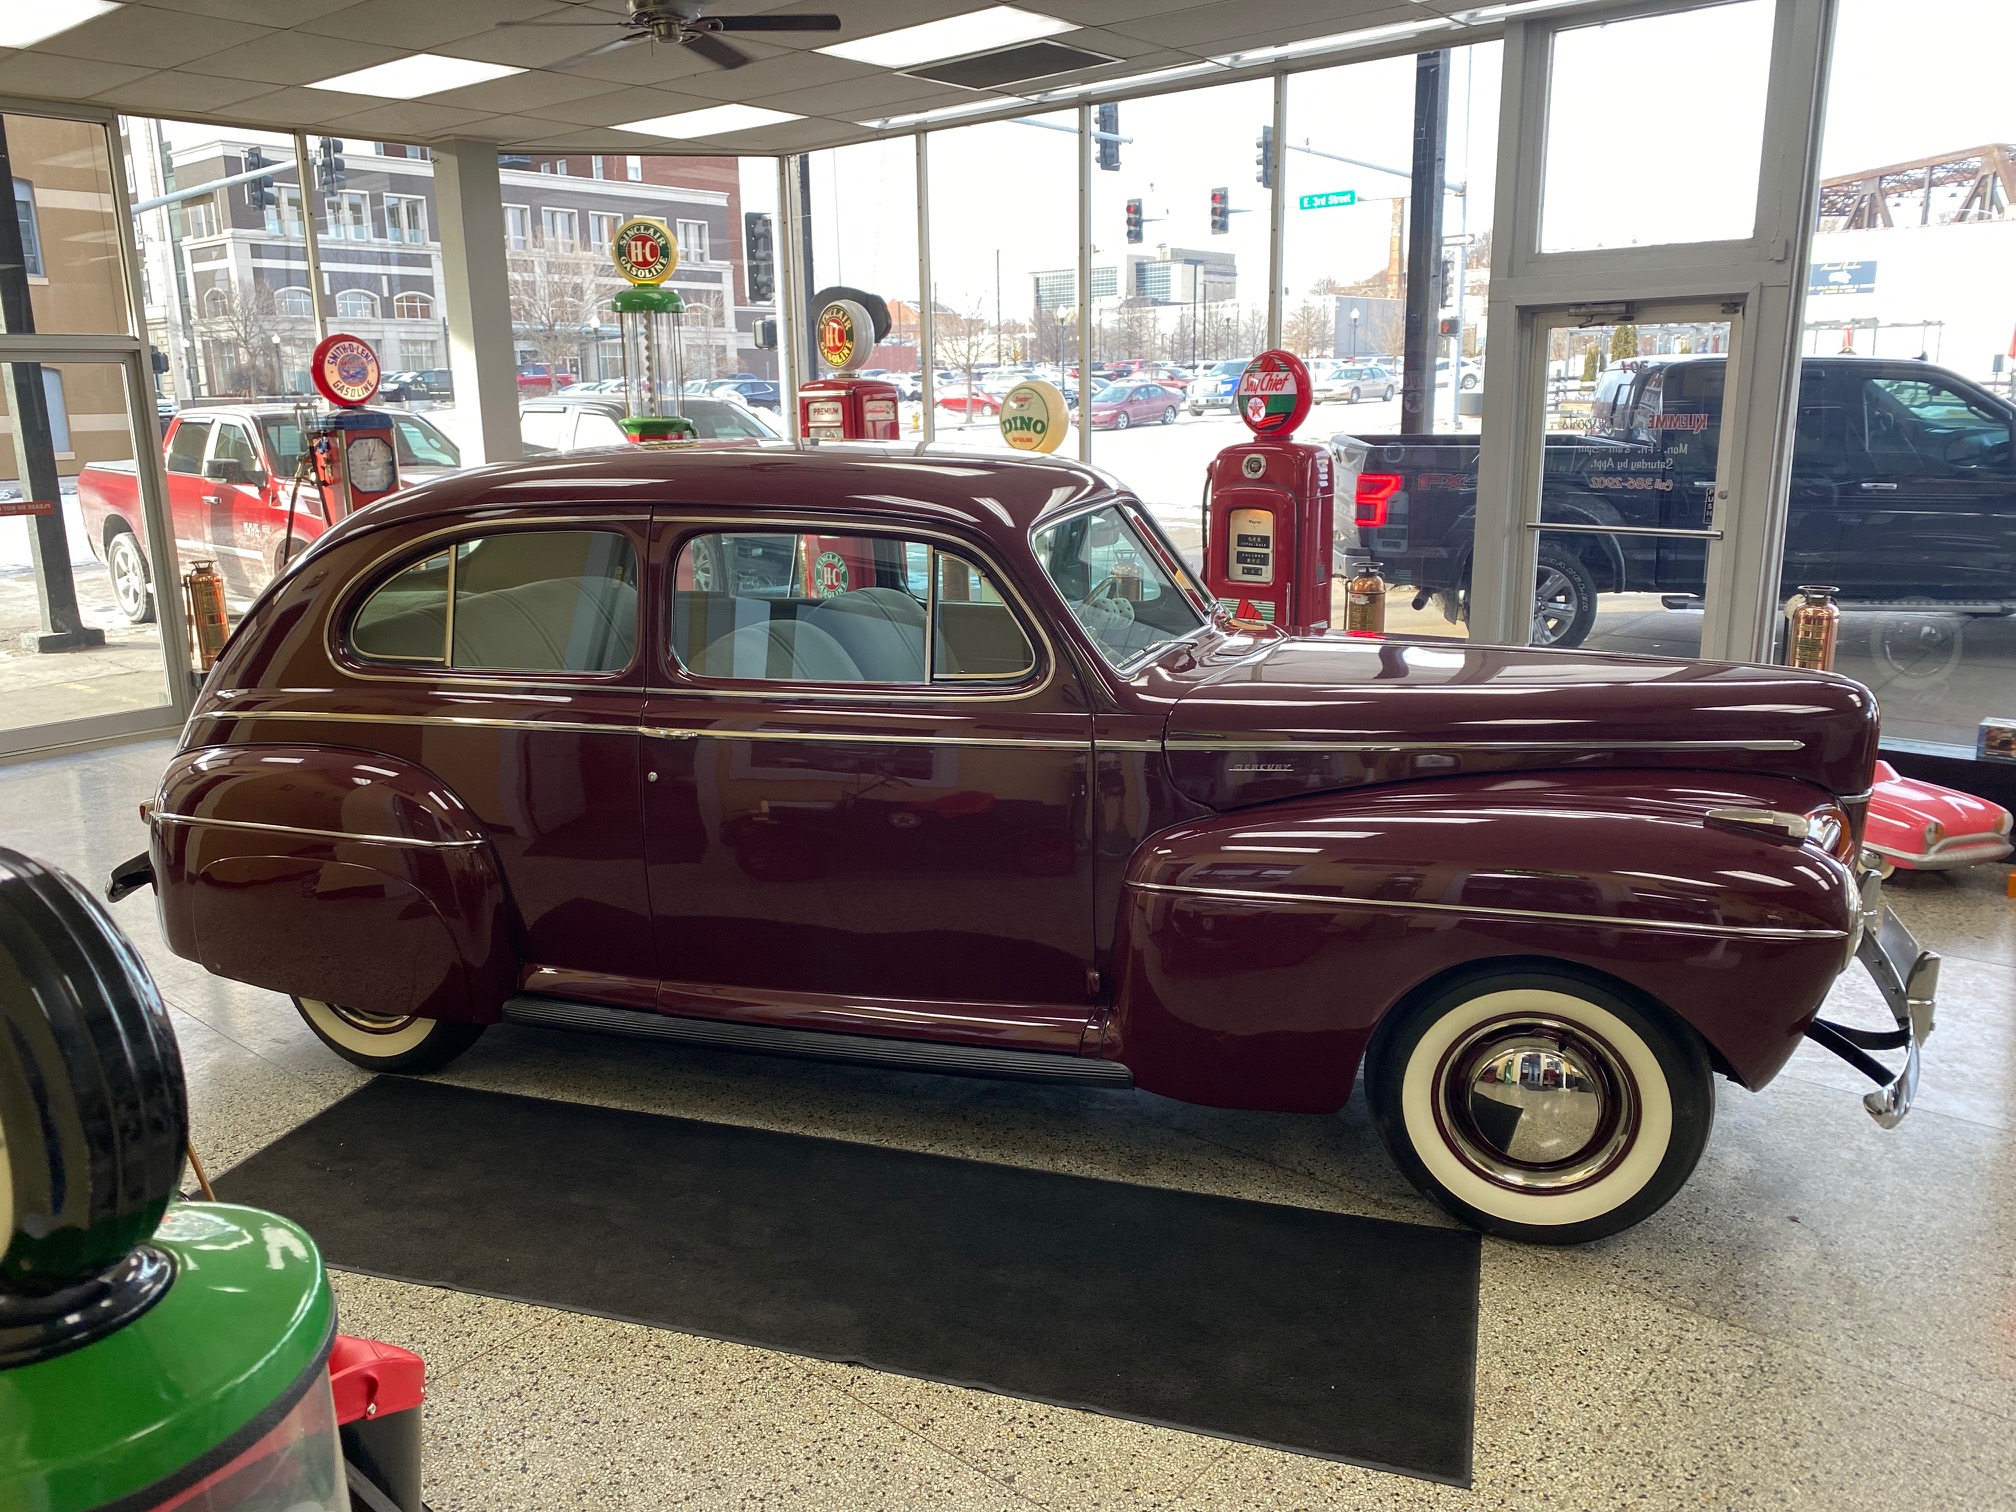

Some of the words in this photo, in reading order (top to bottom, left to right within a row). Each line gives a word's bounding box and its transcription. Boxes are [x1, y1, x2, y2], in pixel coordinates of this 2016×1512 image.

[1303, 197, 1310, 208] E
[1313, 196, 1327, 207] 3rd
[1328, 193, 1352, 205] Street
[619, 225, 666, 247] SINCLAIR
[620, 256, 668, 278] GASOLINE
[820, 308, 852, 331] SINCLAIR
[820, 340, 853, 363] GASOLINE
[332, 379, 375, 398] GASOLINE
[1260, 372, 1291, 392] Chief
[813, 407, 839, 416] PREMIUM
[1002, 415, 1046, 435] DINO
[1706, 488, 1715, 517] PUSH
[818, 554, 846, 574] SINCLAIR
